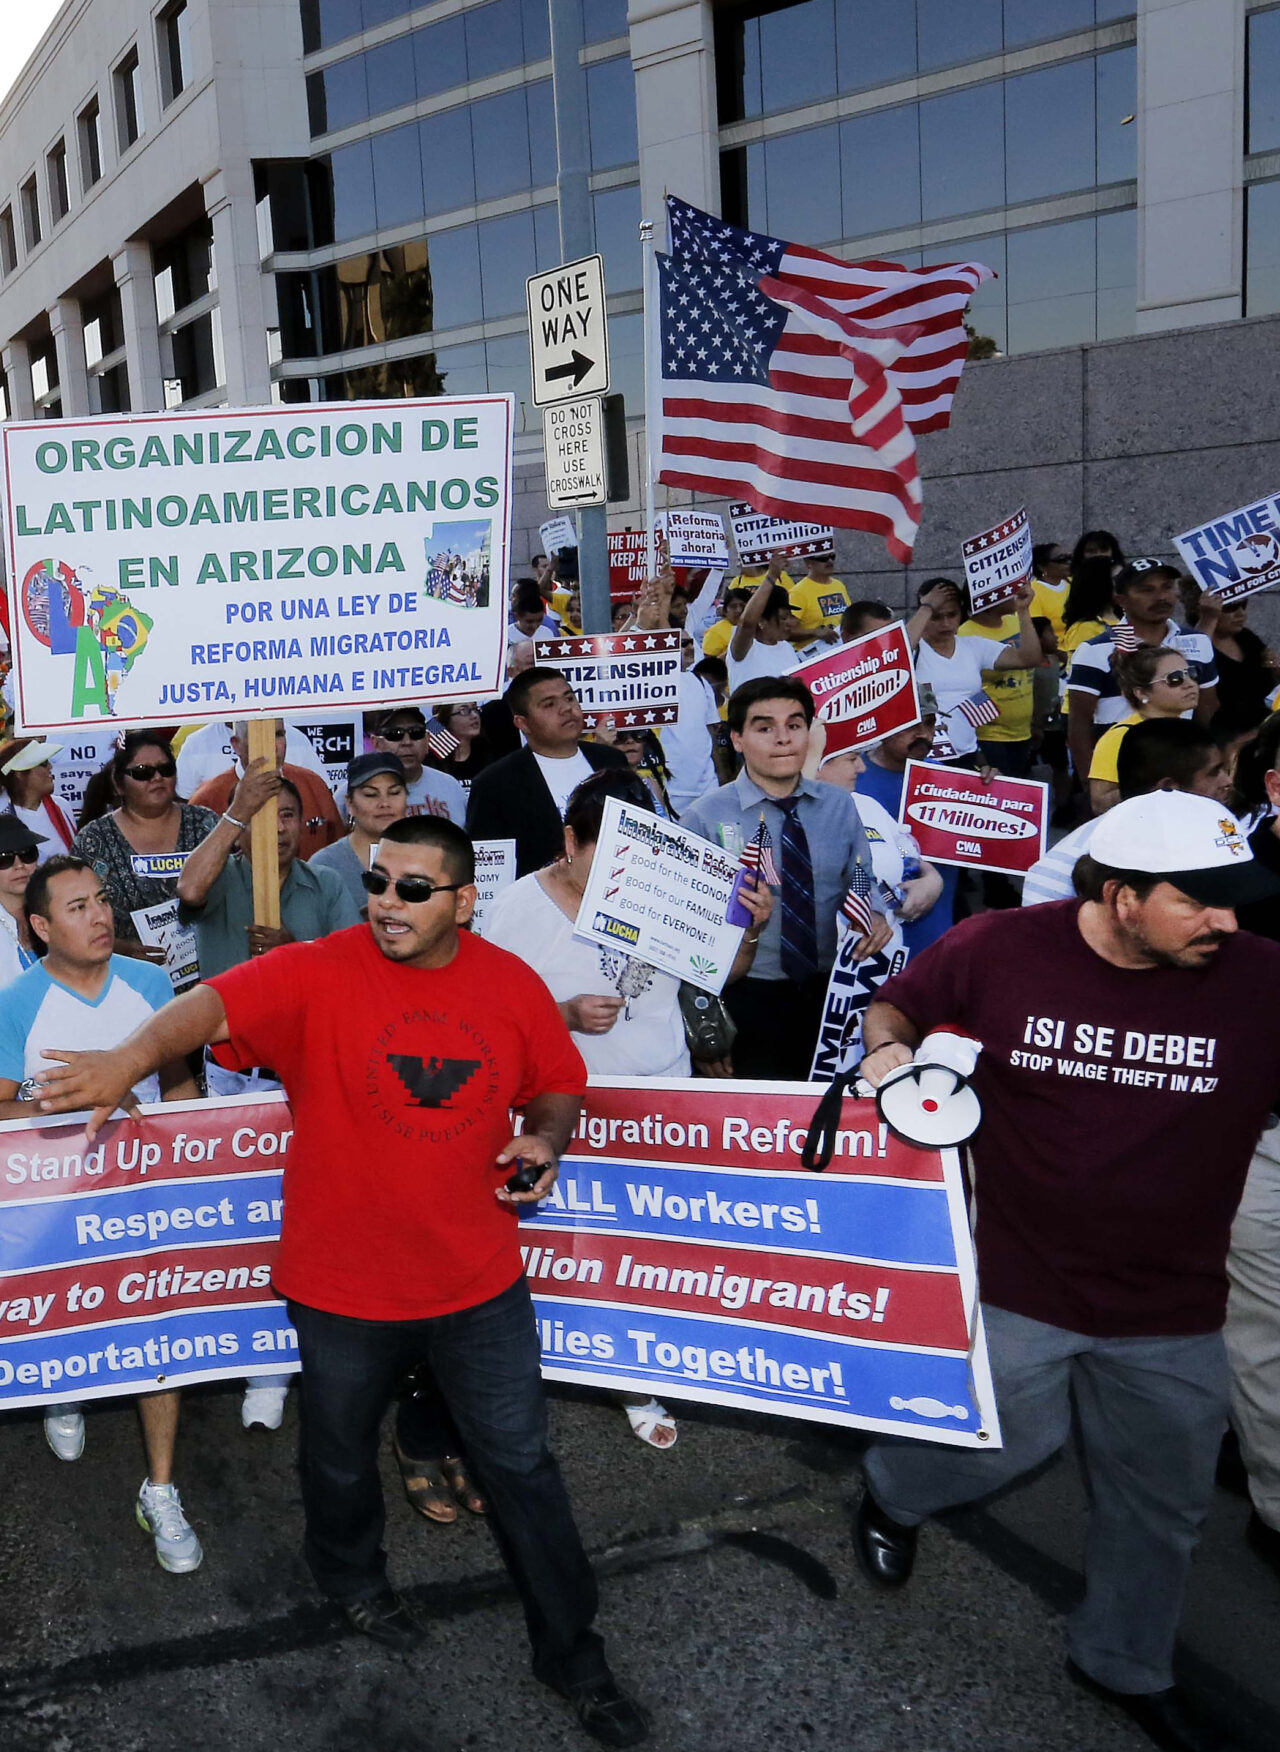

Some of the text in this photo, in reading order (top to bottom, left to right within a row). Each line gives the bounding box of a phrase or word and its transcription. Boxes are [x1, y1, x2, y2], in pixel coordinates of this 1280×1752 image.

[541, 272, 589, 312] ONE
[542, 307, 591, 347] WAY
[551, 405, 592, 424] DO NOT
[35, 417, 479, 473] ORGANIZACION DE
[554, 422, 591, 440] CROSS
[559, 440, 588, 457] HERE
[563, 459, 585, 474] USE
[551, 473, 602, 493] CROSSWALK
[17, 476, 500, 536] LATINOAMERICANOS
[668, 515, 719, 527] ¡Reforma
[670, 528, 724, 540] migratoria
[1181, 504, 1275, 557] TIME
[607, 536, 623, 550] THE
[682, 542, 716, 553] ahora!
[738, 525, 830, 548] for 11 million
[120, 542, 406, 589] EN ARIZONA
[611, 553, 635, 567] KEEP
[969, 537, 1025, 573] CITIZENS
[972, 565, 1009, 590] for 11
[1222, 576, 1267, 598] LL IN FOR
[226, 592, 417, 624] POR UNA LEY DE
[191, 628, 451, 664] REFORMA MIGRATORIA
[159, 662, 482, 704] JUSTA, HUMANA E INTEGRAL
[561, 660, 677, 682] TIZENSHIP
[810, 648, 900, 696] Citizenship for
[574, 683, 676, 703] 11 million
[825, 671, 901, 721] 11 Million!
[307, 727, 323, 736] WE
[857, 717, 876, 734] CWA
[71, 746, 95, 760] NO
[313, 736, 350, 751] RCH
[914, 784, 1034, 812] ¡Ciudadania para
[919, 806, 1026, 836] 11 Millones!
[618, 810, 738, 885] Immigration Refor
[956, 841, 981, 853] CWA
[150, 858, 182, 871] LUCH
[475, 874, 500, 882] NOMY
[631, 854, 731, 904] good for the ECONOM
[478, 891, 494, 900] LIES
[625, 875, 723, 926] good for our FAMILIES
[607, 920, 638, 942] LUCHA
[620, 896, 645, 914] good
[647, 907, 662, 920] for
[663, 915, 707, 945] EVERYONE
[811, 992, 851, 1082] IME
[1023, 1016, 1216, 1068] ¡SI SE DEBE!
[1010, 1050, 1052, 1071] STOP
[1057, 1059, 1107, 1080] WAGE
[1112, 1067, 1167, 1090] THEFT
[1171, 1074, 1187, 1092] IN
[6, 1144, 105, 1185] Stand
[117, 1138, 161, 1174] Up
[171, 1132, 222, 1164] for
[537, 1180, 821, 1233] ALL Workers!
[76, 1199, 234, 1244] Respect
[67, 1283, 105, 1310] to
[118, 1265, 271, 1303] Citizens
[616, 1255, 890, 1323] Immigrants!
[252, 1328, 298, 1352] an
[628, 1330, 846, 1397] Together!
